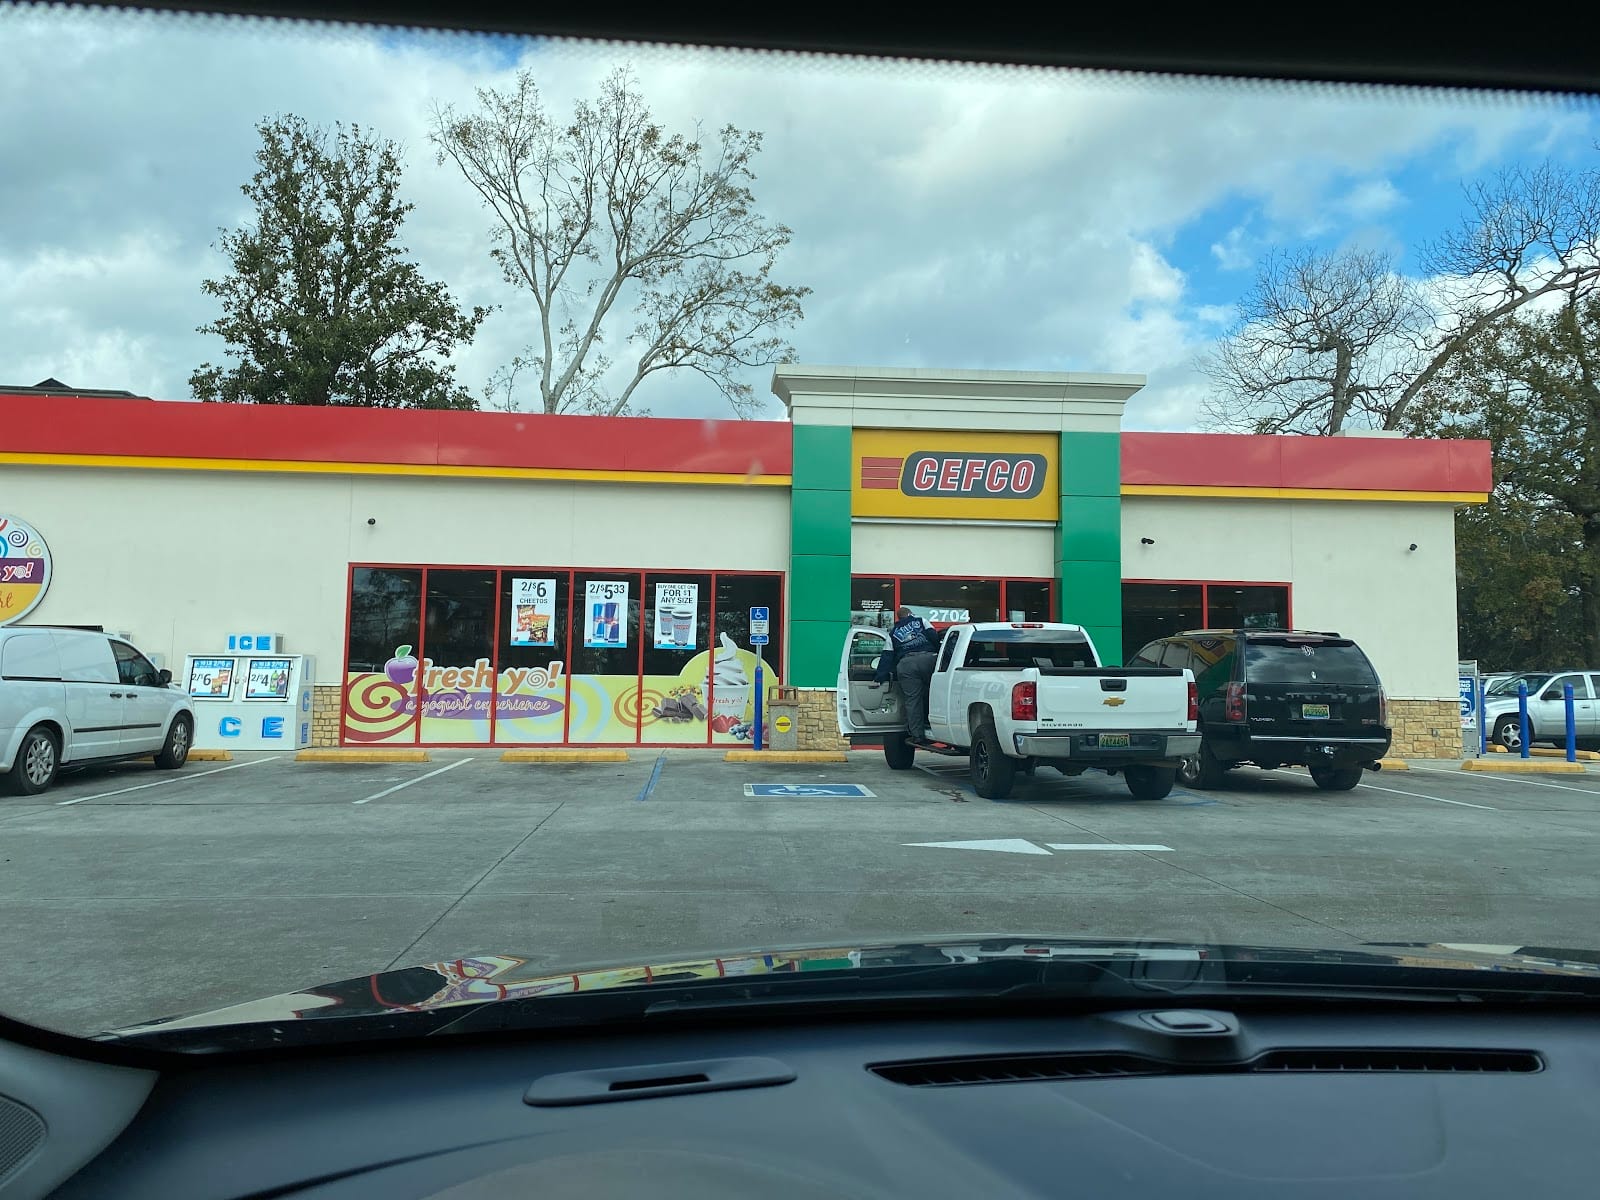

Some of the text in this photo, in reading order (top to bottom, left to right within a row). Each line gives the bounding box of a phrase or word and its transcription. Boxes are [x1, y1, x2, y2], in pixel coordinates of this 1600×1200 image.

[912, 457, 1036, 493] CEFCO
[521, 581, 547, 597] 2/$6
[928, 609, 970, 622] 2704
[228, 635, 271, 651] ICE
[191, 673, 211, 686] 2/$6
[251, 674, 270, 687] 2/$4
[407, 659, 494, 695] fresh
[419, 694, 472, 716] yogurt
